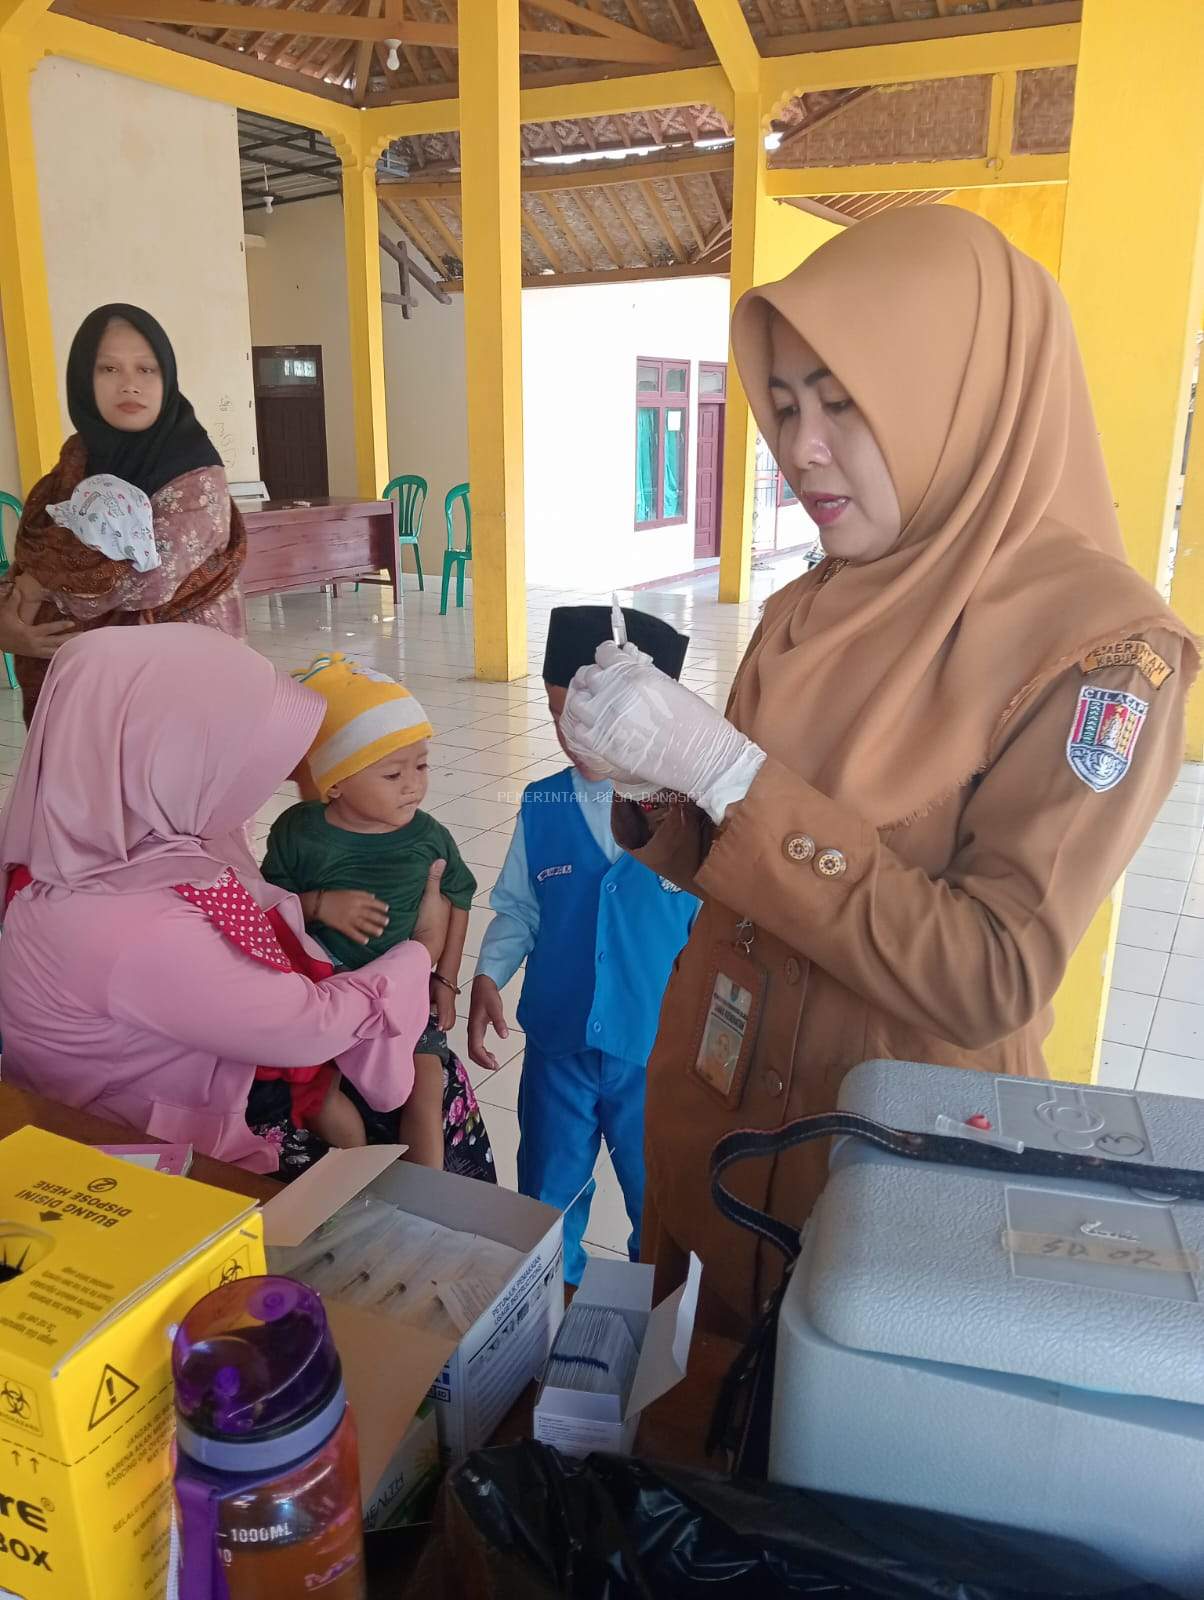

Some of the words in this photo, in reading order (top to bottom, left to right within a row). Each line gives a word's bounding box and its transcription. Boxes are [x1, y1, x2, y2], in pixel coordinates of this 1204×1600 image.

[1083, 688, 1148, 714] CILACAP
[14, 1189, 64, 1209] DISINI
[32, 1180, 73, 1196] HERE
[62, 1203, 119, 1228] BUANG
[70, 1192, 133, 1217] DISPOSE
[230, 1522, 293, 1543] 1000ML
